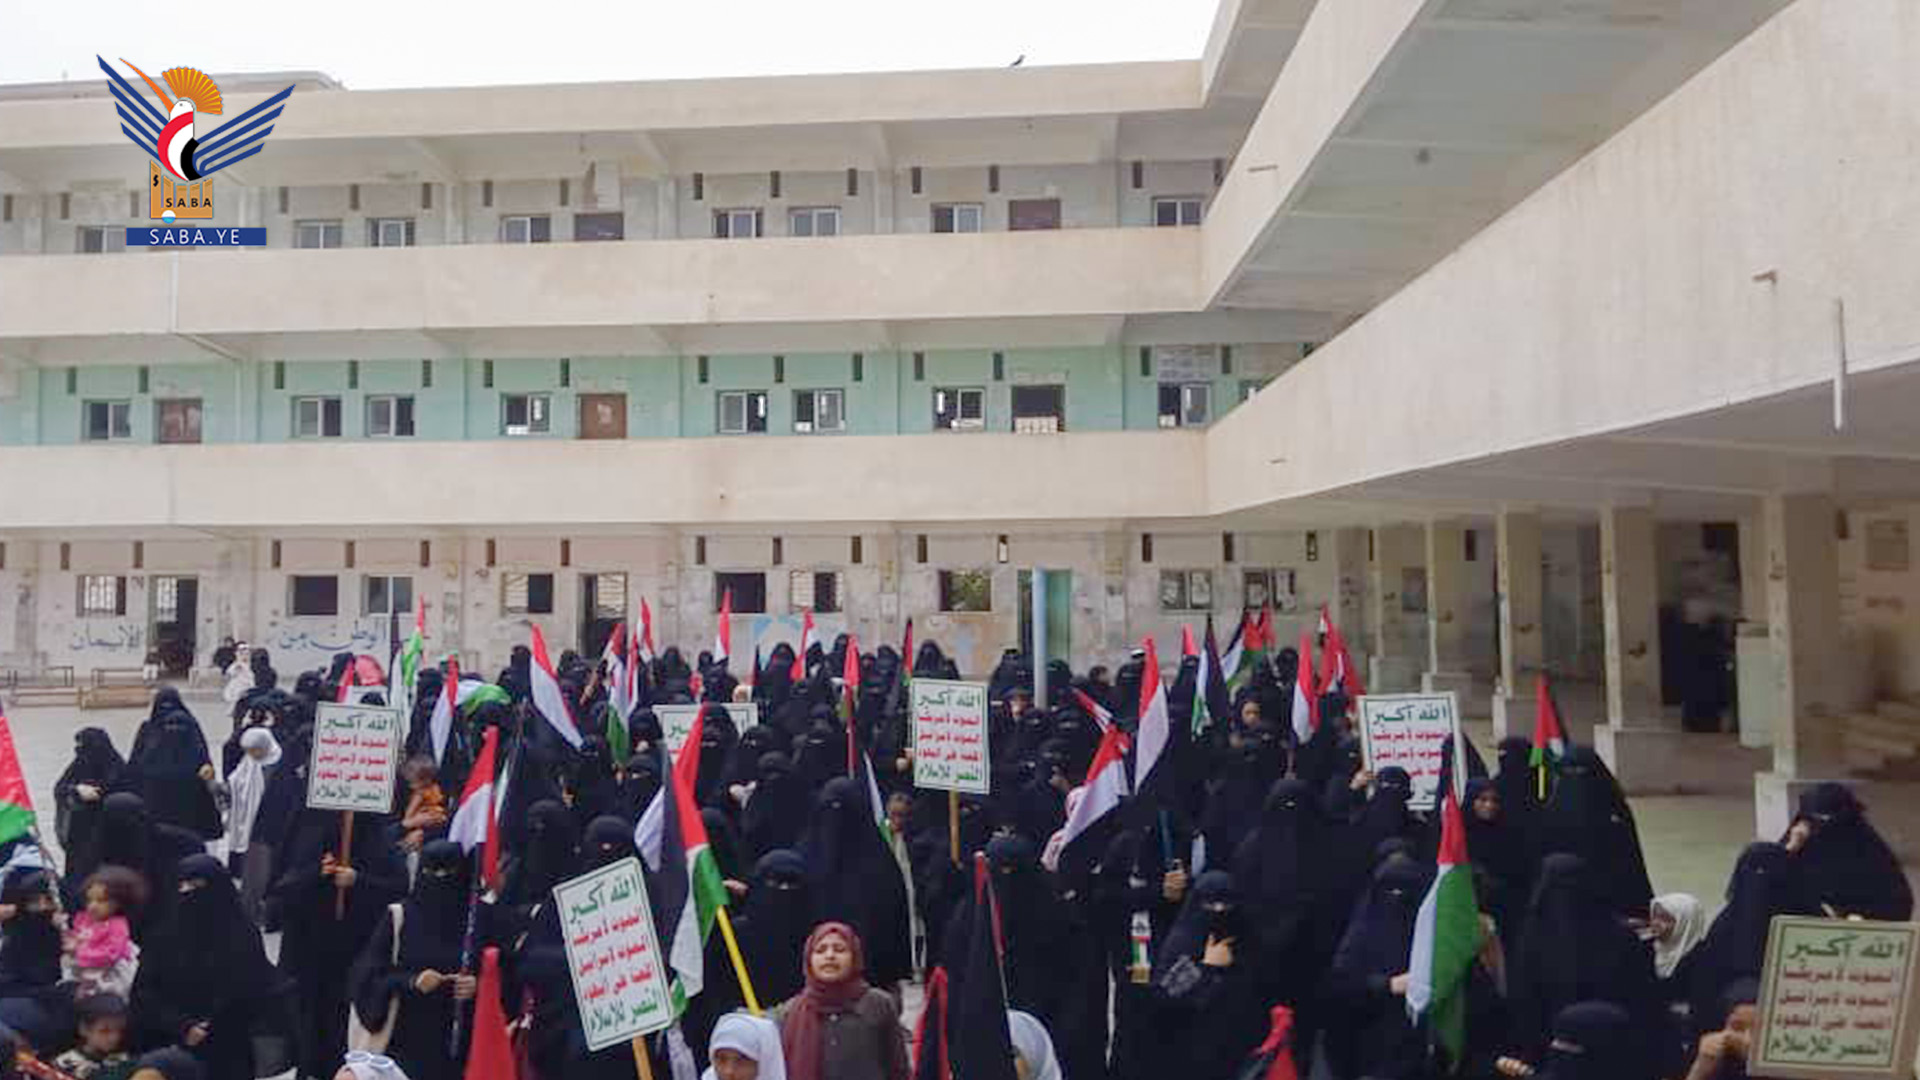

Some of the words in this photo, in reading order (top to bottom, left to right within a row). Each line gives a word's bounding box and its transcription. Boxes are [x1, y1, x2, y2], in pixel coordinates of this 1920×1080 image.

[1419, 703, 1446, 721] الله
[611, 874, 637, 902] الله
[1860, 935, 1904, 958] الله
